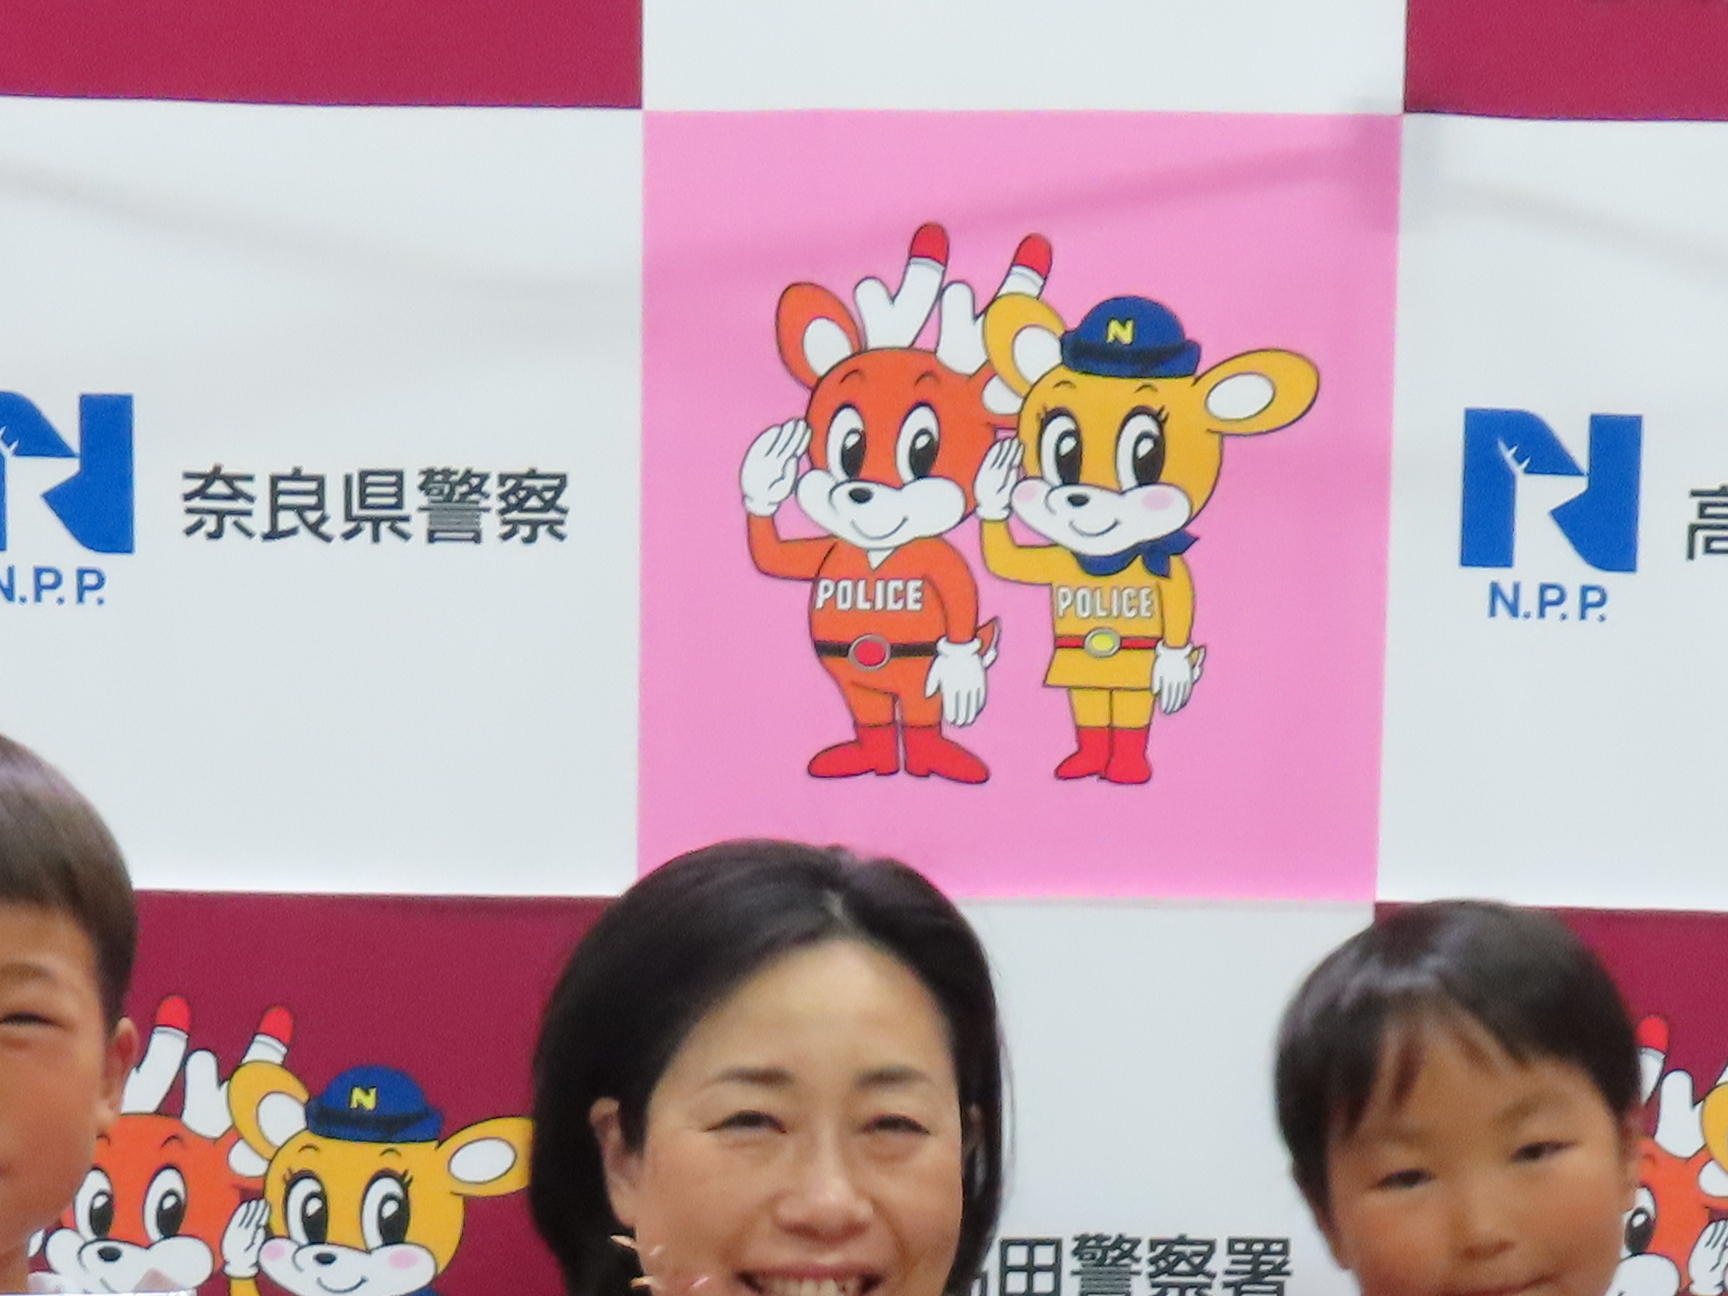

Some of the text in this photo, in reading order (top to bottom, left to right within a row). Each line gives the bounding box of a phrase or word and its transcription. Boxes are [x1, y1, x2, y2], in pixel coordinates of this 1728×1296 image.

[182, 465, 569, 545] 奈良県警察
[815, 578, 925, 612] POLICE
[1055, 585, 1154, 619] POLICE
[1488, 581, 1609, 622] N.P.P.
